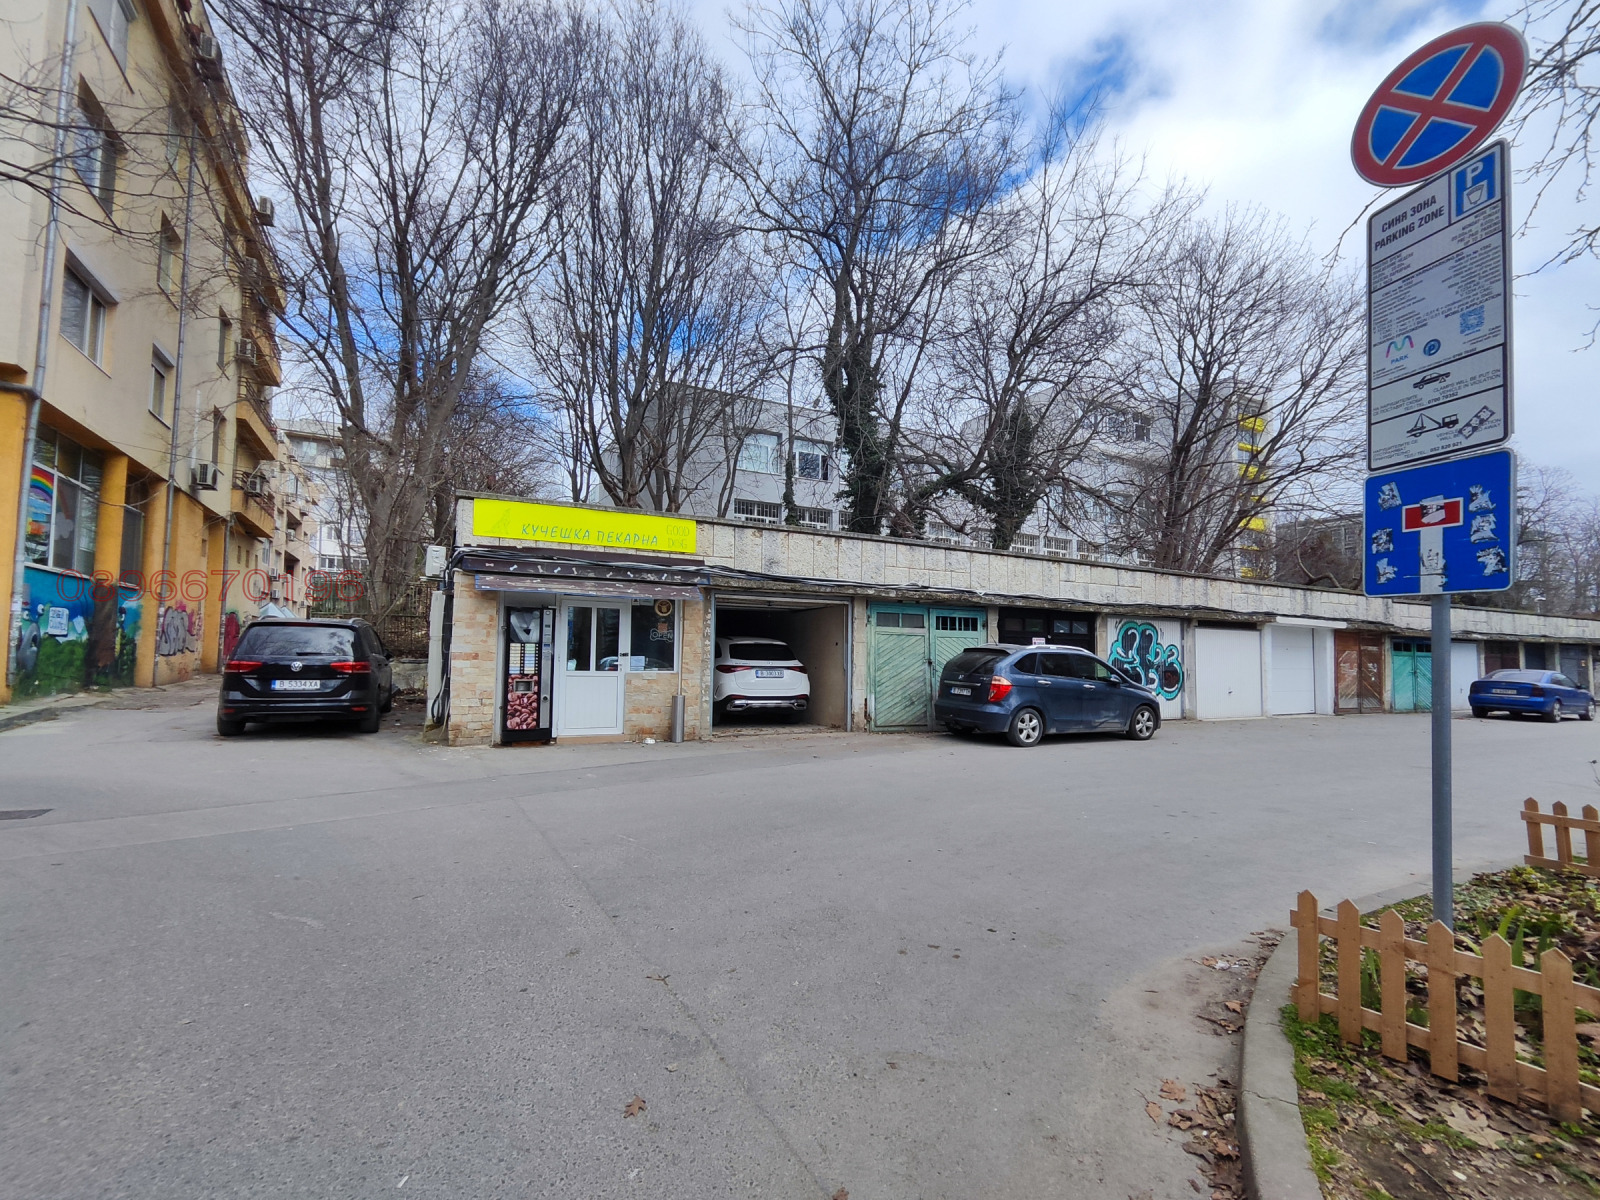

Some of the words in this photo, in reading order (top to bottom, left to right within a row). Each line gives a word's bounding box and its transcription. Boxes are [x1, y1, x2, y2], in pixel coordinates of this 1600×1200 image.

[1466, 160, 1483, 187] P
[1381, 210, 1407, 232] СИНЯ
[1410, 194, 1436, 217] ЗОНА
[1374, 220, 1415, 251] PARKING
[1417, 204, 1444, 229] ZONE
[1465, 292, 1501, 310] APPLICATION
[1390, 353, 1408, 364] PARK
[1455, 377, 1467, 386] WILL
[1478, 370, 1490, 378] PUT
[1470, 372, 1500, 386] VIOLATION
[1427, 396, 1440, 404] 0700
[522, 523, 590, 541] КУЧЕШКА
[597, 530, 658, 546] ПЕКАРНА
[666, 524, 690, 537] GOOD
[668, 537, 688, 549] DOG
[652, 631, 673, 640] OPEN
[279, 680, 285, 688] B
[288, 680, 307, 688] 5334
[308, 680, 318, 688] XA
